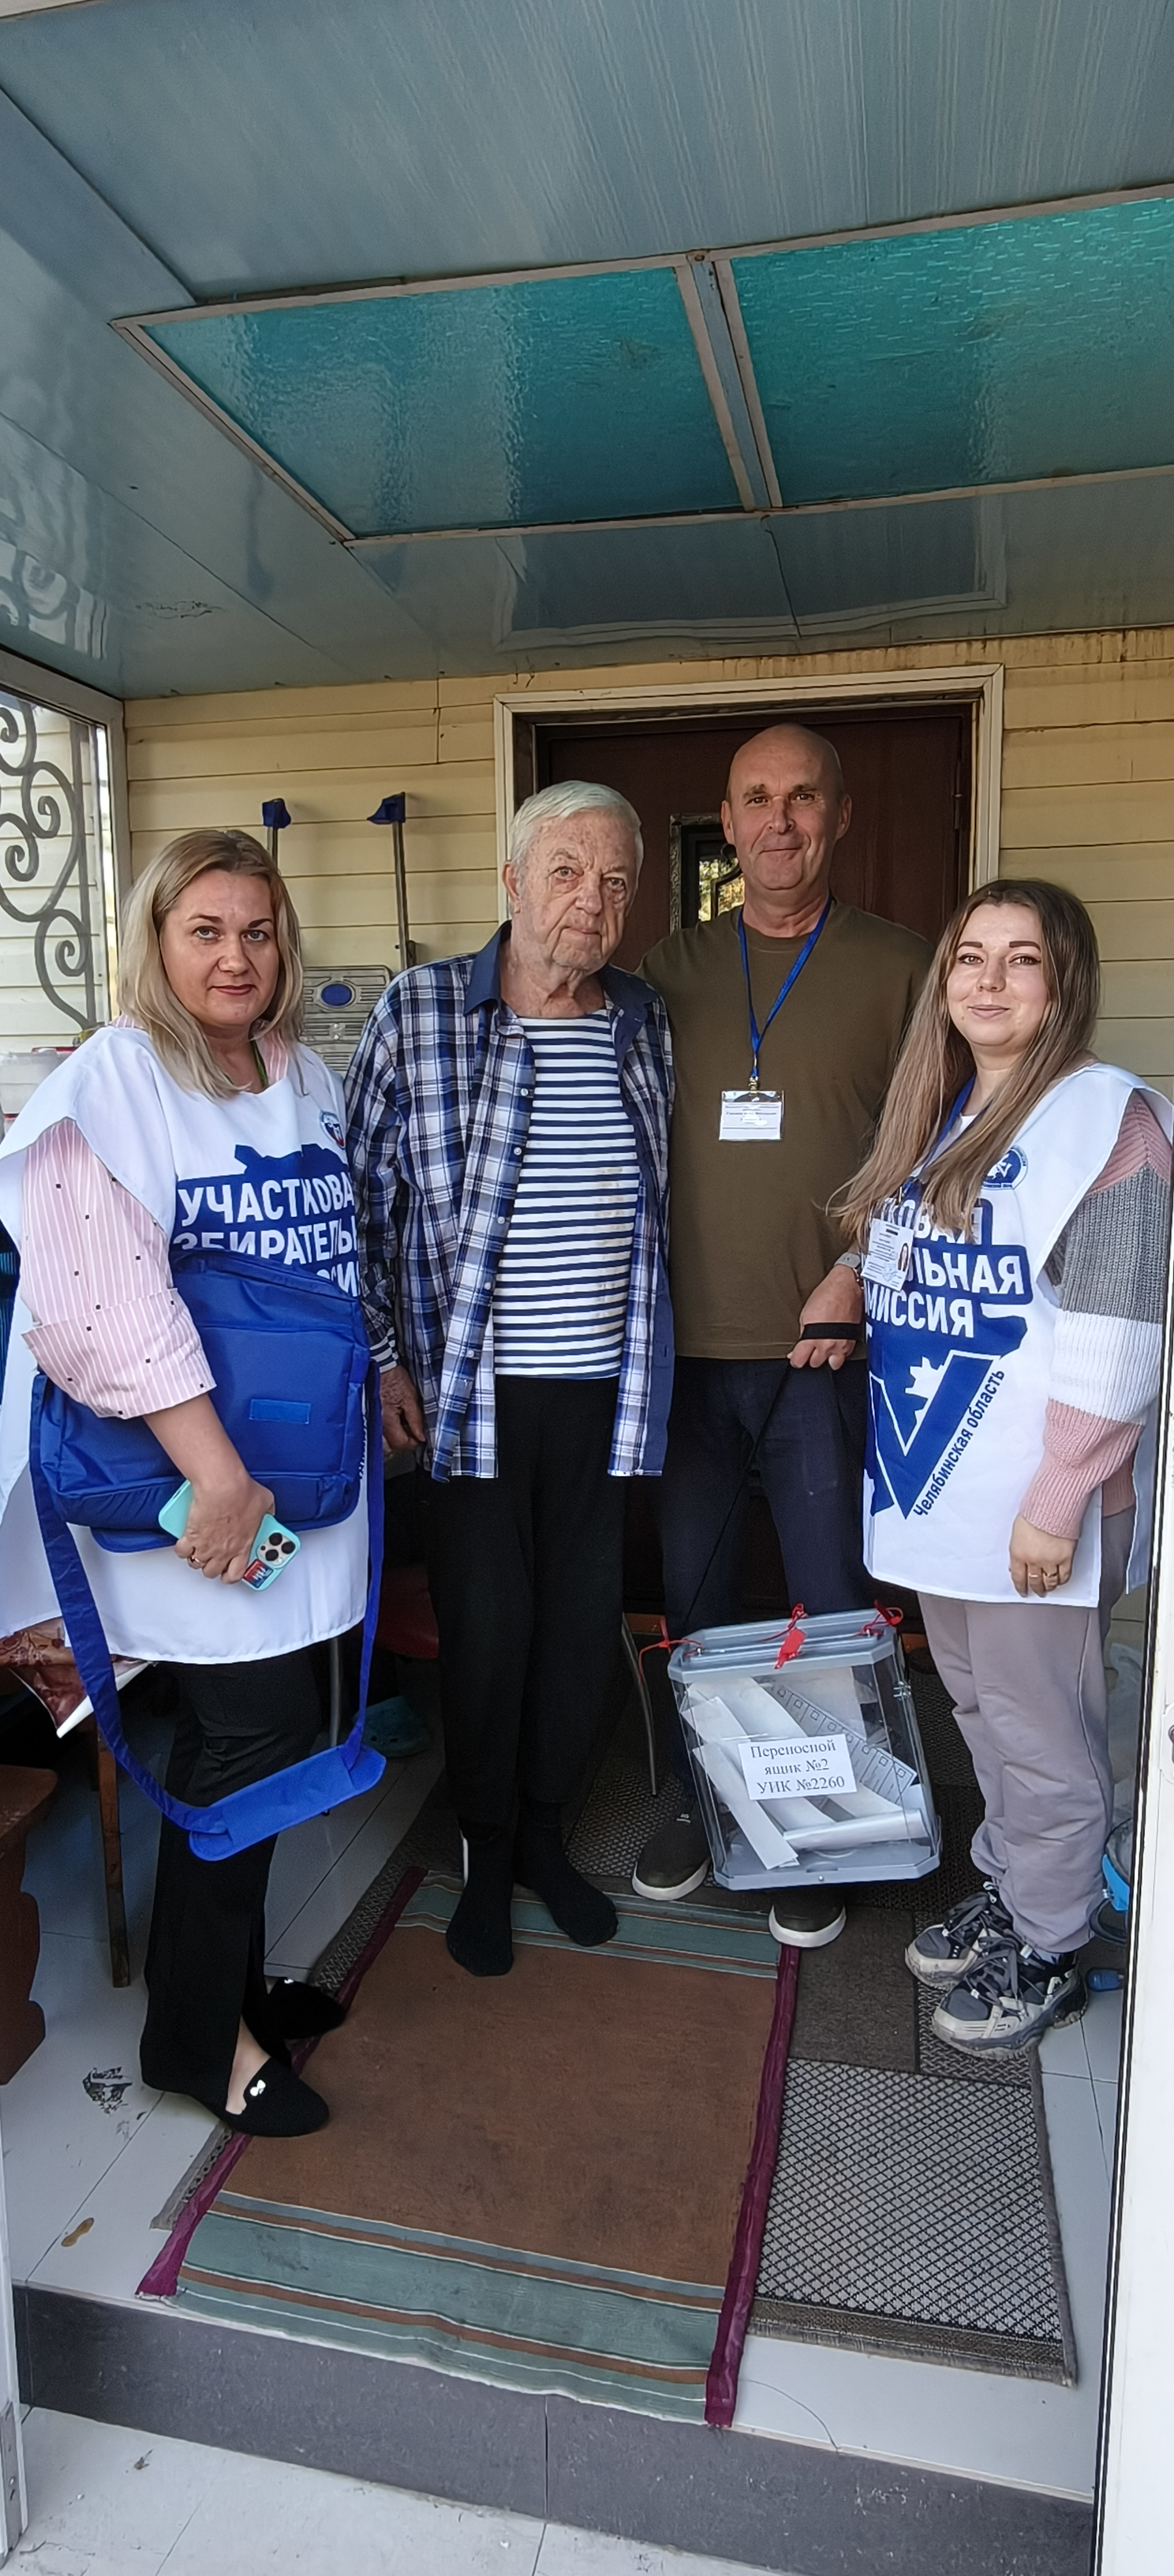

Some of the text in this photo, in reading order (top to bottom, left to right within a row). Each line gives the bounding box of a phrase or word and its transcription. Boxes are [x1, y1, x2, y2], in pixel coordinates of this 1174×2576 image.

[178, 1172, 355, 1226] УЧАСТКОВА
[913, 1369, 1005, 1515] Челябинская область
[750, 1739, 836, 1760] Переносной
[765, 1758, 829, 1775] ящик №2
[757, 1776, 845, 1794] УИК №2260
